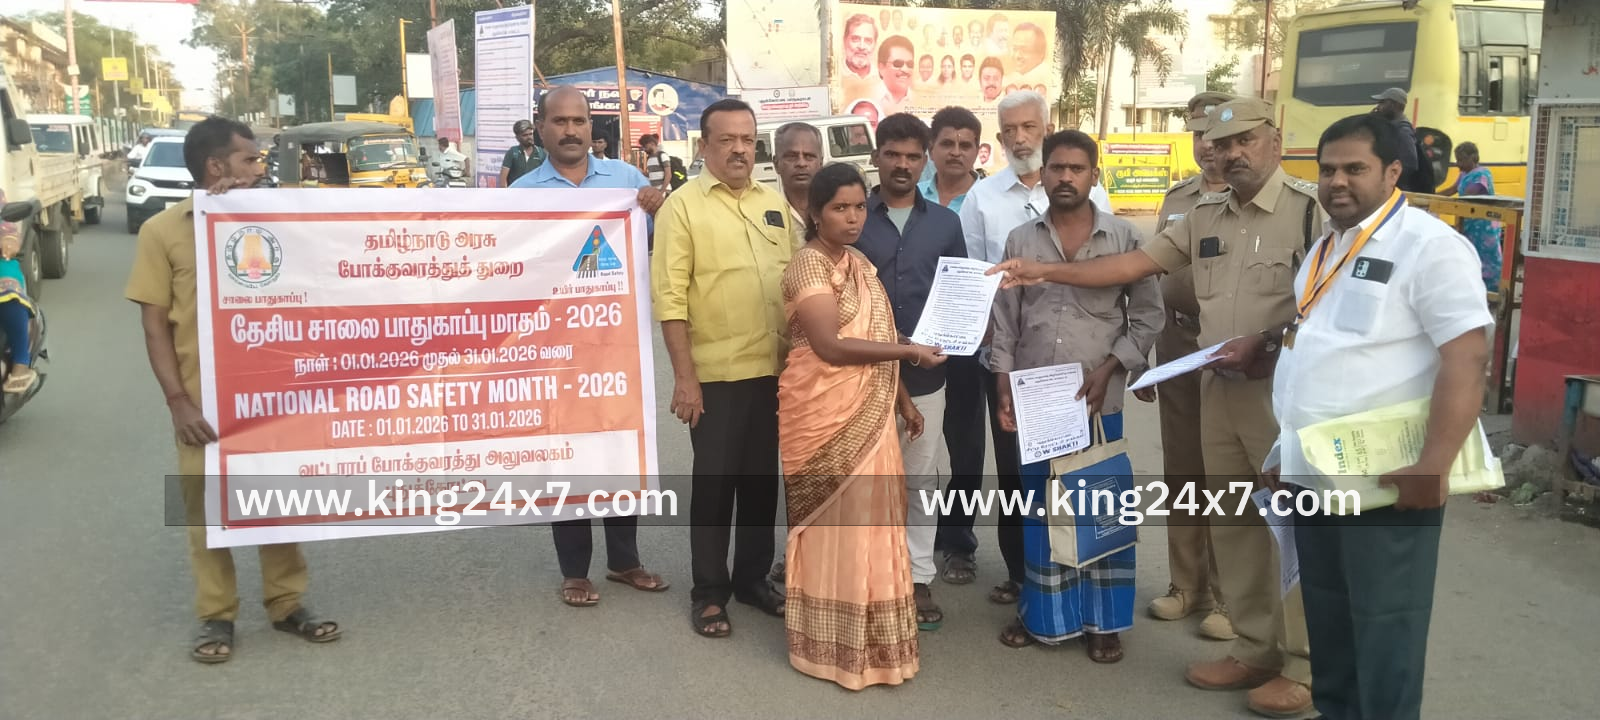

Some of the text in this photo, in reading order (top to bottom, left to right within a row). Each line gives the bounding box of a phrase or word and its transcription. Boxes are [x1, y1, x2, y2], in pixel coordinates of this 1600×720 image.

[364, 227, 497, 253] தமிழ்நாடு அரசு
[338, 255, 525, 281] போக்குவரத்துத் துறை
[222, 294, 253, 305] சாலை
[255, 291, 303, 306] பாதுகாப்பு
[231, 313, 303, 352] தேசிய
[308, 317, 379, 341] சாலை
[385, 307, 487, 345] பாதுகாப்பு
[490, 304, 550, 341] மாதம்
[566, 302, 622, 328] 2026
[294, 353, 329, 379] நாள்
[340, 350, 420, 371] 01.01.2026
[422, 347, 461, 372] முதல்
[464, 344, 537, 366] 31.01.2026
[540, 343, 573, 361] வரை
[234, 387, 340, 419] NATIONAL
[345, 384, 401, 413] ROAD
[407, 380, 482, 409] SAFETY
[488, 375, 558, 404] MONTH
[577, 371, 628, 398] 2026
[332, 419, 366, 439] DATE
[376, 415, 449, 437] 01.01.2026
[452, 413, 468, 432] TO
[471, 409, 542, 430] 31.01.2026
[298, 442, 574, 478] வட்டாரப் போக்குவரத்து அலுவலகம்
[1333, 437, 1347, 474] Index
